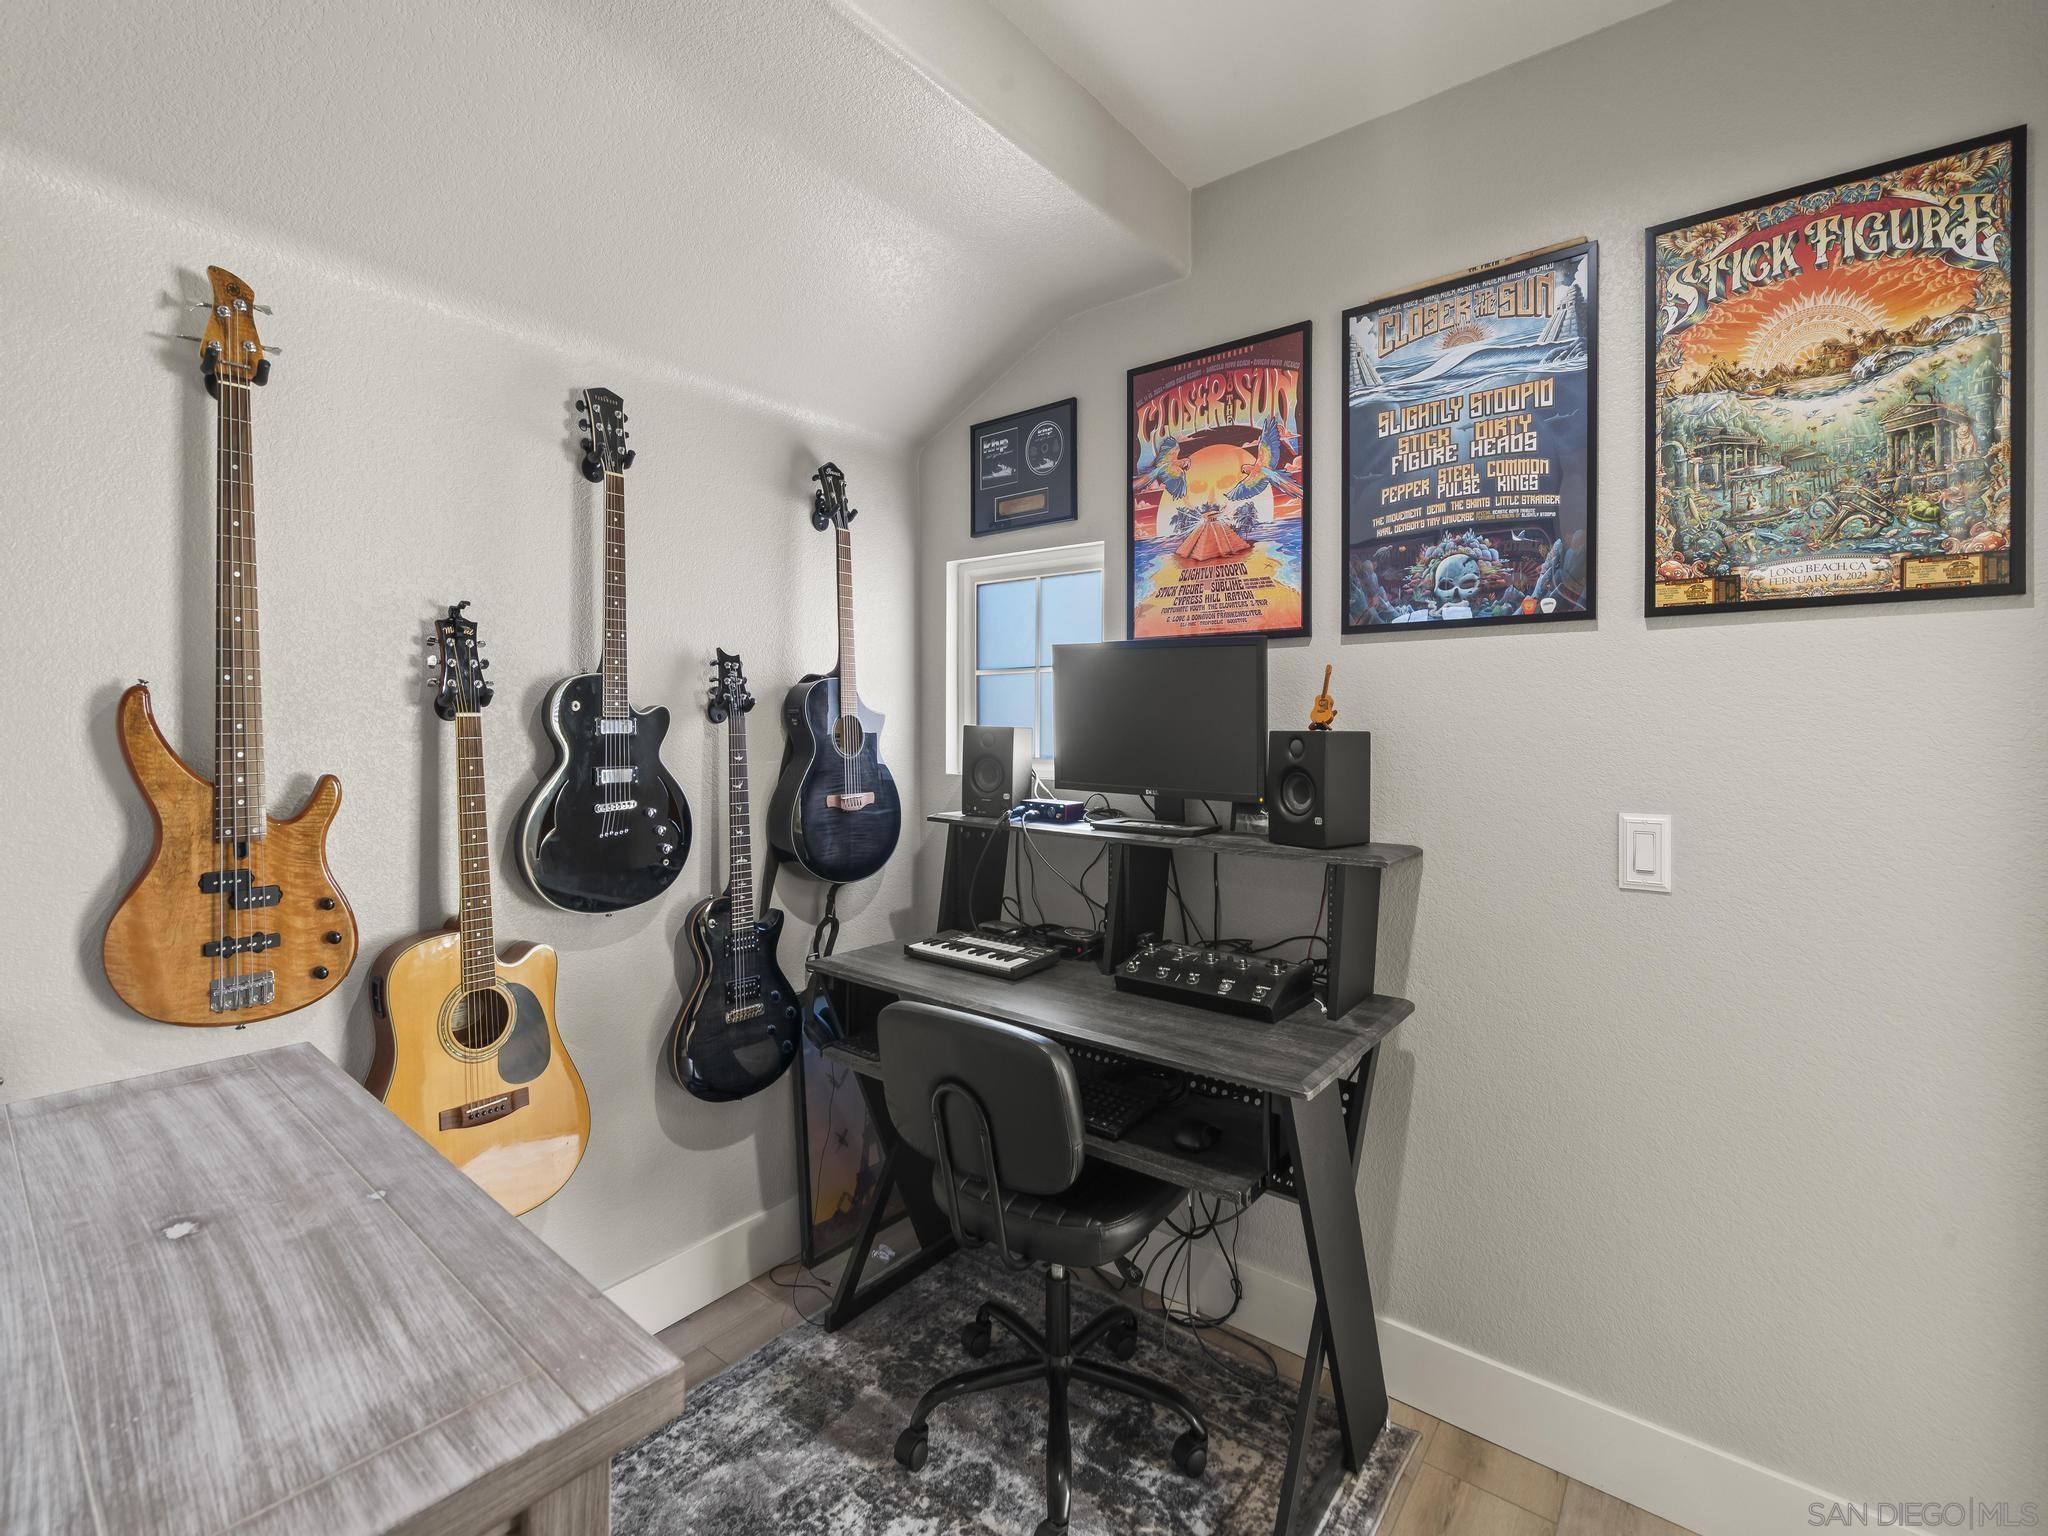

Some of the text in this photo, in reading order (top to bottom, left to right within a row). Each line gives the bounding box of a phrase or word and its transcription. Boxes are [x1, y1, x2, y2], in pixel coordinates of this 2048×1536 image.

[1662, 193, 2000, 335] STICK FIGURE
[1474, 297, 1496, 318] THE
[1497, 271, 1555, 318] SUN
[1378, 291, 1472, 358] CLOSER
[1226, 371, 1234, 392] TO
[1226, 395, 1234, 426] THE
[1234, 368, 1298, 455] SUN
[1378, 377, 1555, 438] SLIGHTLY STOOPID
[1137, 373, 1227, 472] CLOSER
[1474, 413, 1532, 440] DIRTY
[1398, 427, 1452, 455] STICK
[1470, 431, 1538, 459] HEADS
[1391, 444, 1458, 476] FIGURE
[1437, 463, 1480, 484] STEEL
[1487, 458, 1549, 478] COMMON
[1381, 477, 1430, 505] PEPPER
[1437, 479, 1480, 499] PULSE
[1497, 474, 1539, 492] KINGS
[1372, 494, 1560, 527] THE MOVEMENT DENM THE SKINTS LITTLE STRANGER
[1376, 512, 1475, 538] KARL DENSON'S TINY UNIVERSE
[1178, 562, 1248, 582] SLIGHTLY STOOPID
[1769, 571, 1868, 586] FEBRUARY 16, 2024
[1770, 561, 1867, 577] LONG BEACH, CA
[1155, 585, 1178, 598] STICK
[1178, 583, 1204, 596] FIGURE
[1211, 579, 1244, 592] SUBLIME
[1173, 590, 1254, 606] CYPRESS HILL IRATION
